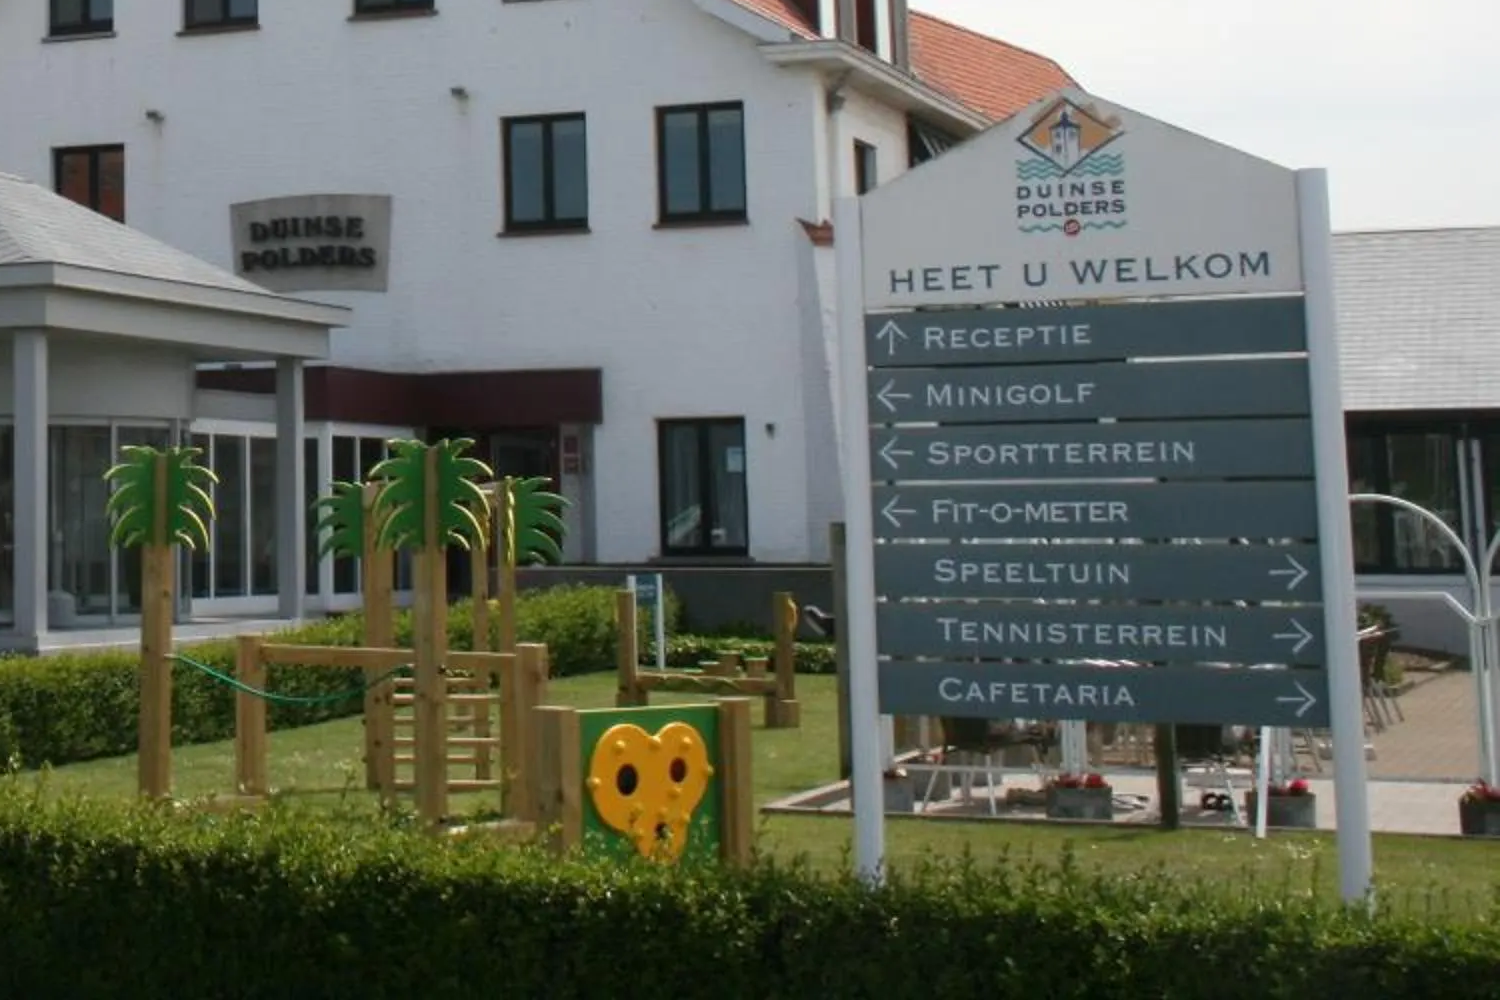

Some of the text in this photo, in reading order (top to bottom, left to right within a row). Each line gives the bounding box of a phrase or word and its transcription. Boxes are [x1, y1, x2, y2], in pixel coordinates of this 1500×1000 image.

[1016, 180, 1125, 200] DUINSE
[1017, 199, 1126, 219] POLDERS
[249, 215, 364, 243] DUINSE
[241, 245, 377, 272] POLDERS
[890, 251, 1270, 294] HEET U WELKOM
